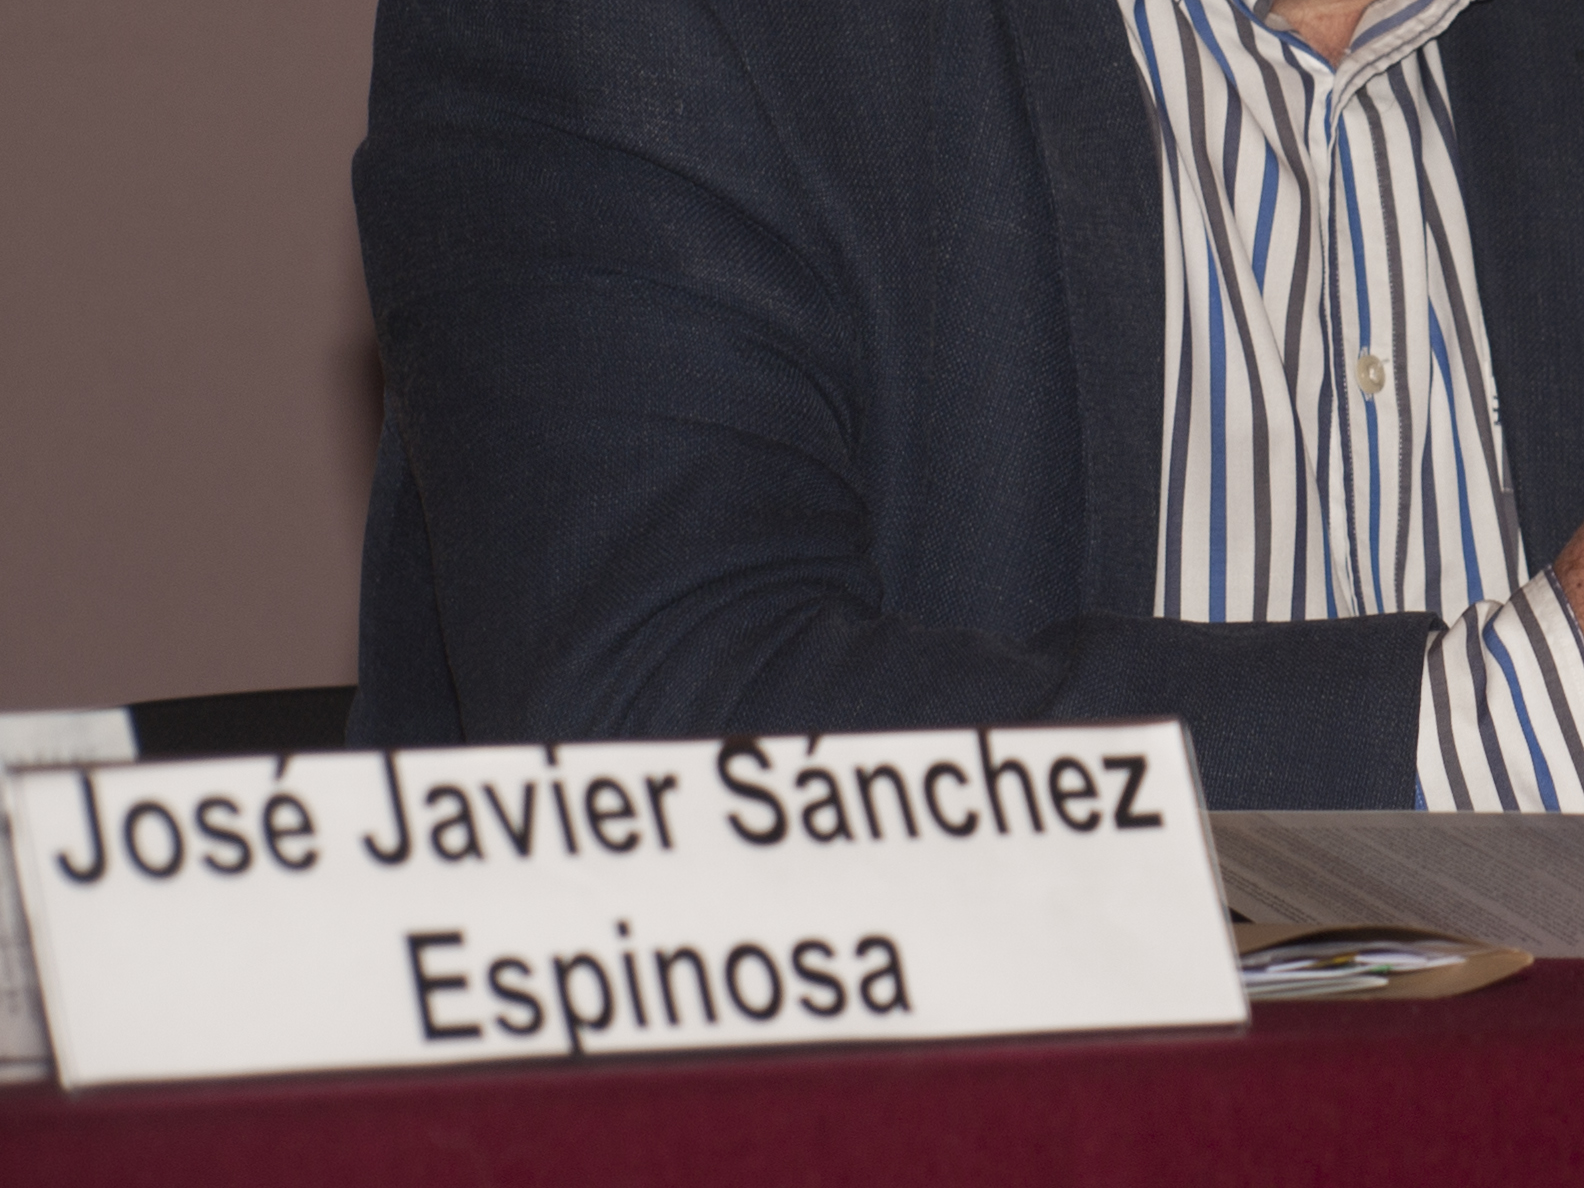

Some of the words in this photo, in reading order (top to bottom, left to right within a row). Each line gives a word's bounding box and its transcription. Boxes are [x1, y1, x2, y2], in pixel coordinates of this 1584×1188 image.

[56, 755, 319, 886] José
[362, 743, 679, 866] Javier
[716, 728, 1164, 847] Sánchez
[404, 918, 913, 1055] Espinosa
